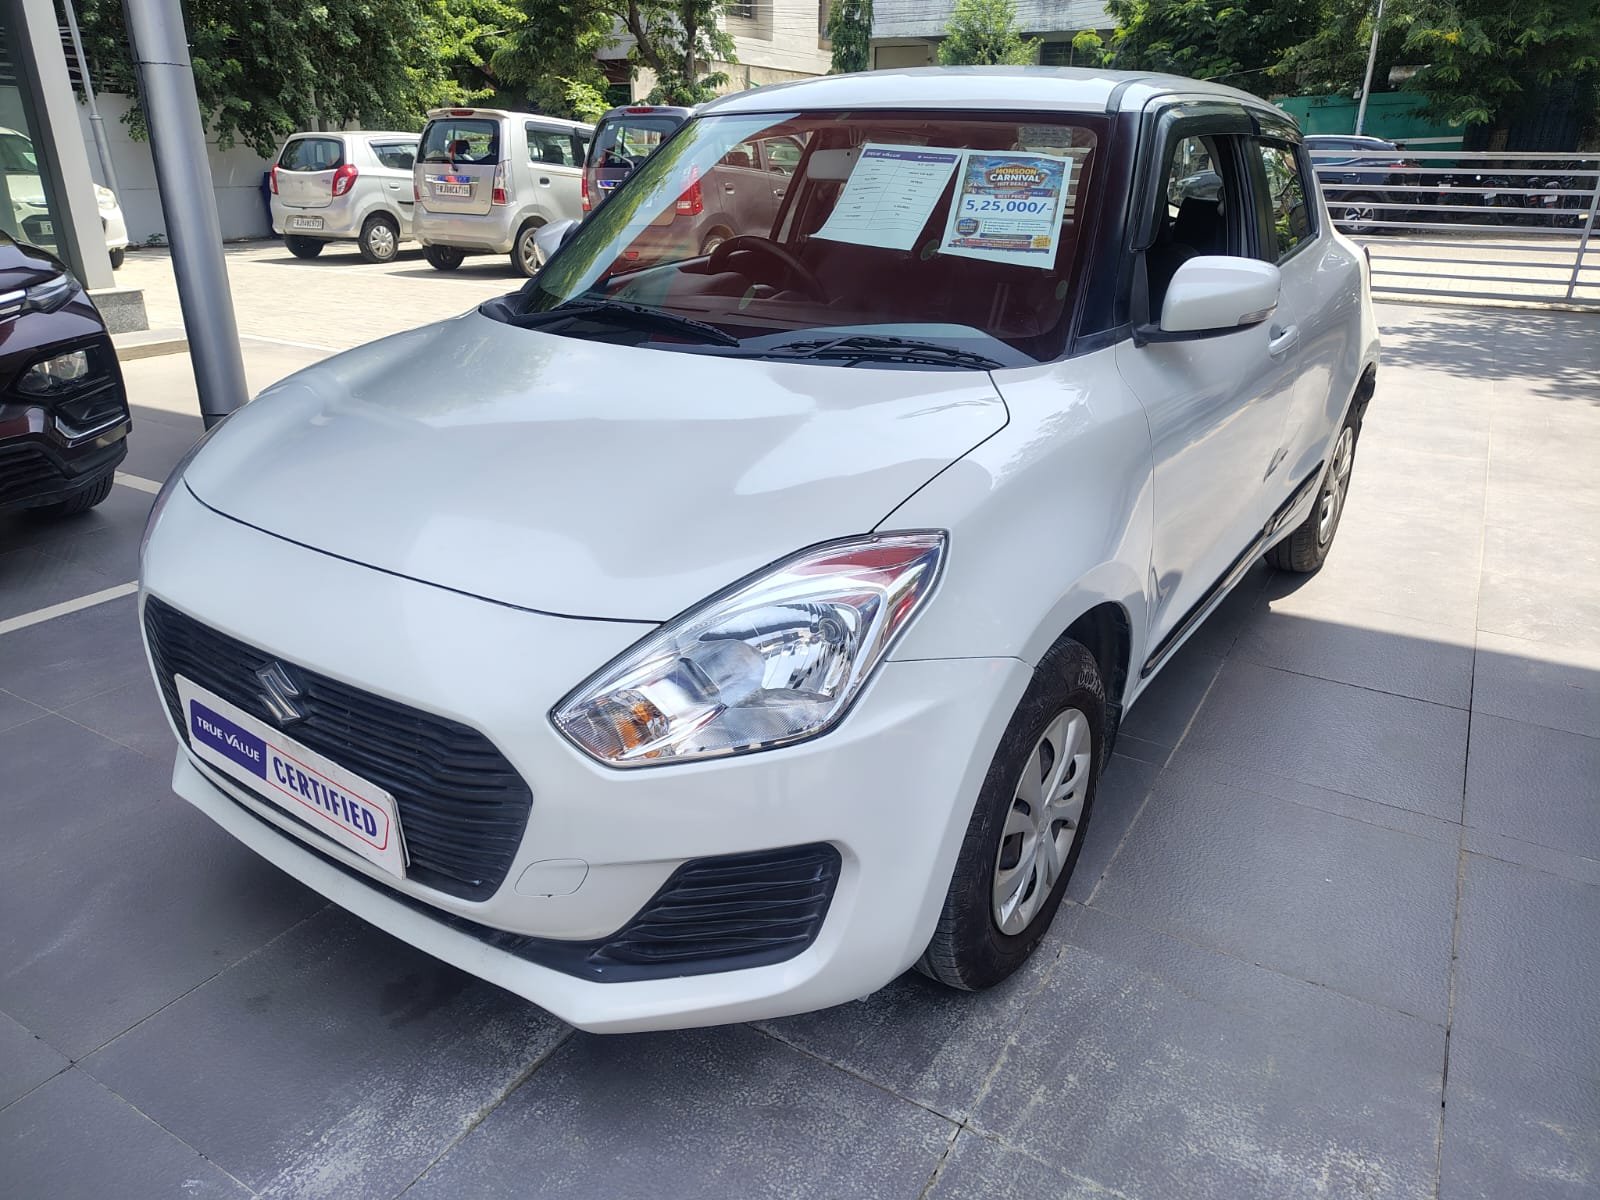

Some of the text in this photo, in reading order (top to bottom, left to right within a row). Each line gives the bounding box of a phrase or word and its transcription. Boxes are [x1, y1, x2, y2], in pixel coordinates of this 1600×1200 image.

[990, 174, 1040, 182] CARNIVAL
[966, 200, 1053, 214] 5,25,000/-
[196, 715, 260, 762] TRUE VALUE
[273, 756, 377, 837] CERTIFIED
